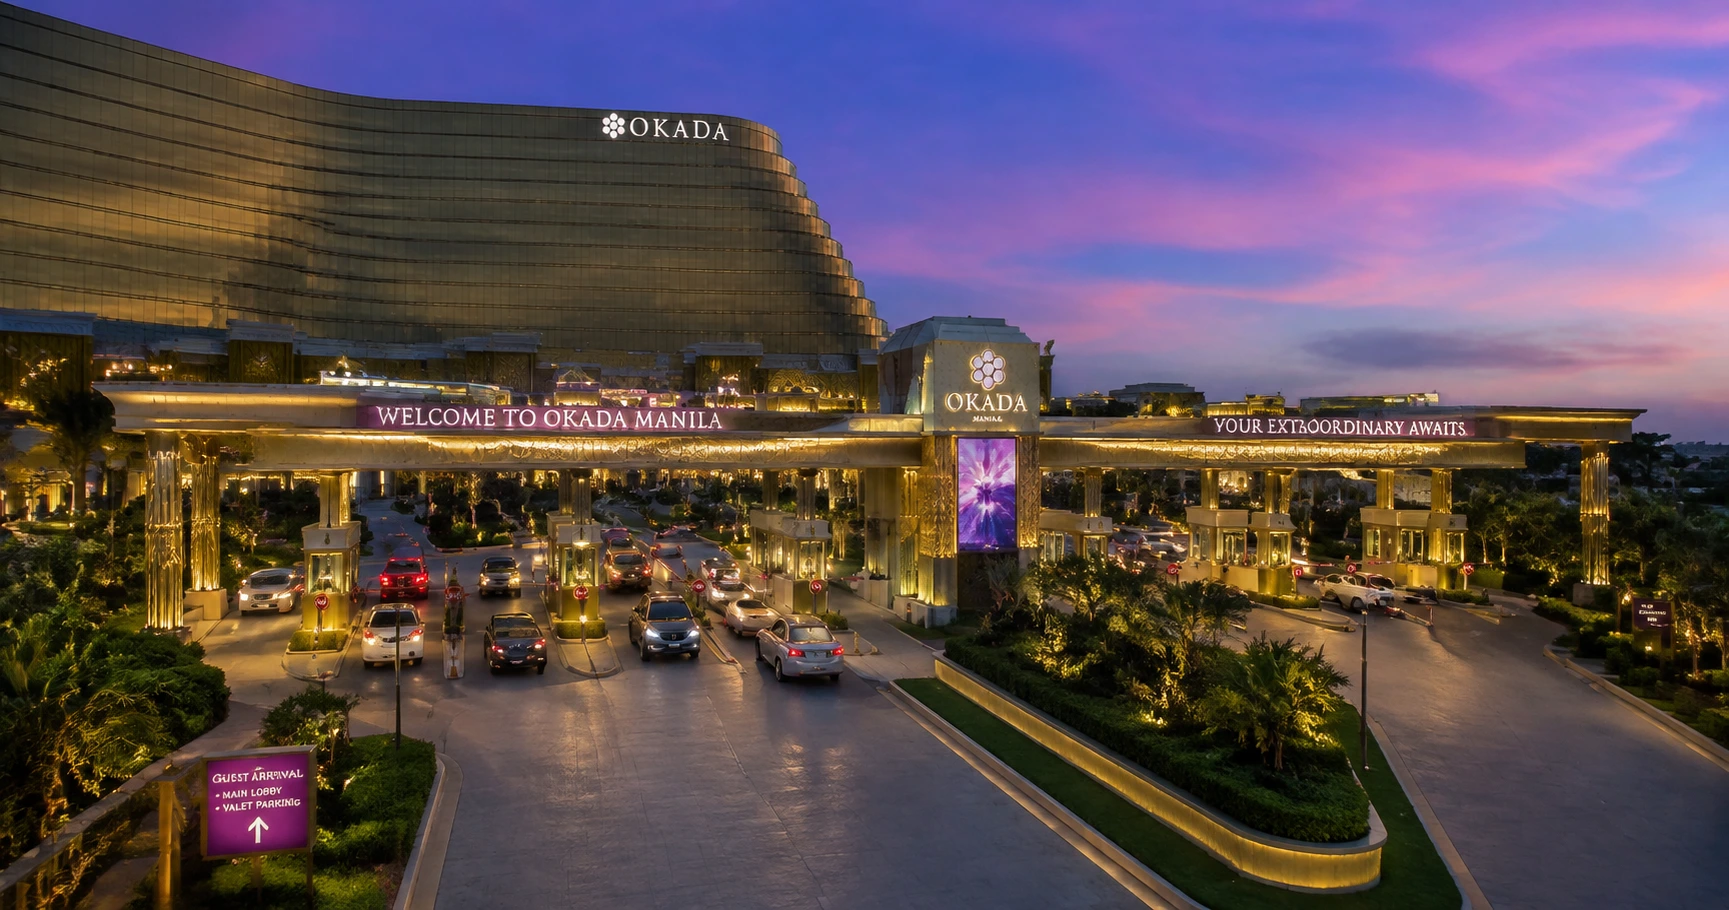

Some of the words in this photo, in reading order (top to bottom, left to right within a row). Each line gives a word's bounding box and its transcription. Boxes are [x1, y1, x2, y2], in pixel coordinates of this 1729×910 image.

[630, 117, 729, 141] OKADA
[945, 392, 1028, 412] OKADA
[376, 406, 496, 426] WELCOME
[503, 408, 536, 427] TO
[543, 409, 627, 428] OKADA
[635, 410, 723, 429] MANILA
[1214, 418, 1263, 433] YOUR
[1409, 420, 1466, 436] AWAITS
[212, 772, 249, 783] GUEST
[222, 789, 248, 799] MAIN
[251, 786, 282, 797] LOBBY
[223, 801, 253, 812] VALET
[256, 798, 301, 810] PARKING
